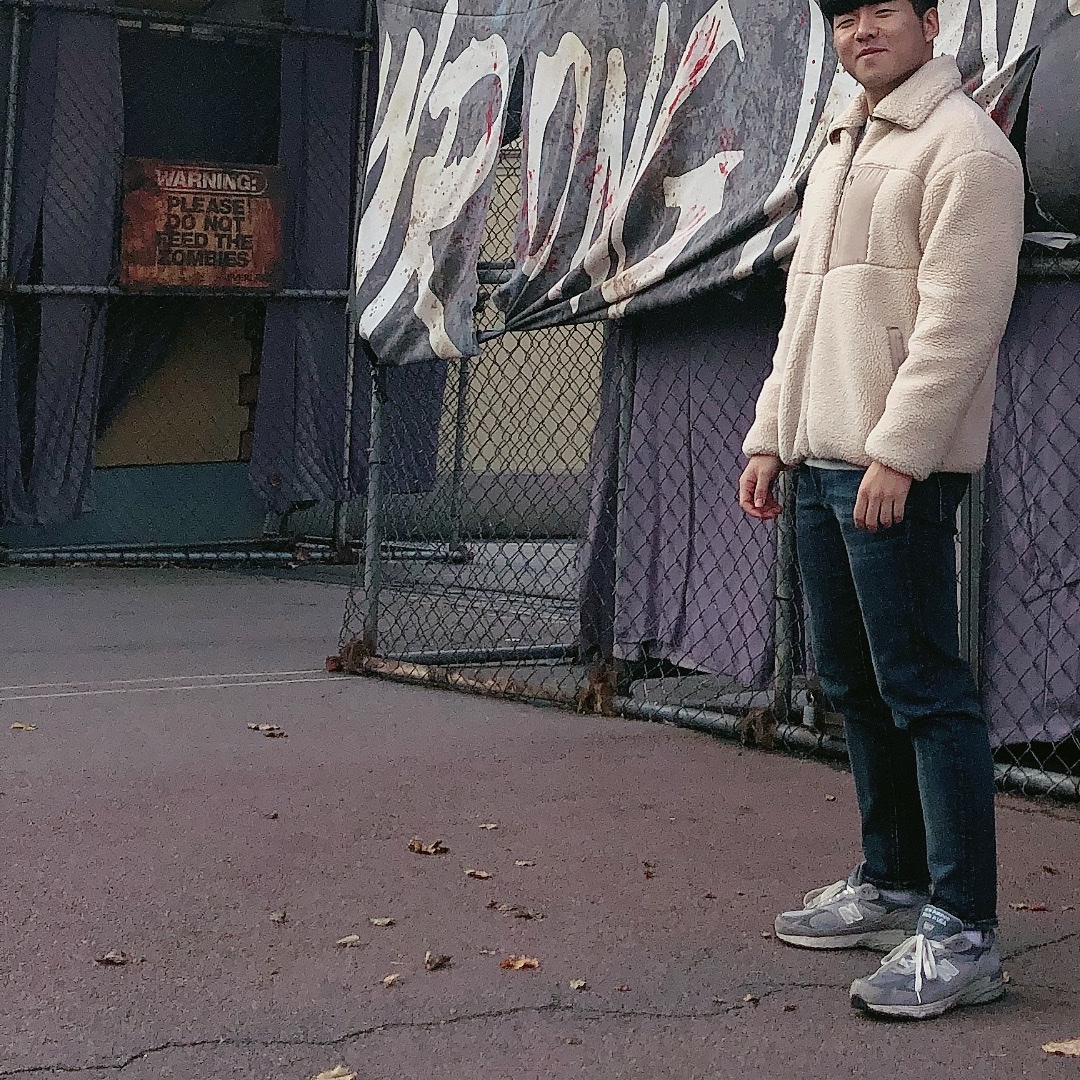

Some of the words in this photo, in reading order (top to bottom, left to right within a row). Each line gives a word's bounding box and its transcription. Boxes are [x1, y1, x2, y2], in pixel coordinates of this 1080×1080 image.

[156, 169, 257, 191] WARNING:
[166, 195, 246, 215] PLEASE
[164, 213, 197, 231] DO
[204, 215, 246, 233] NOT
[156, 230, 209, 249] FEED
[215, 233, 254, 250] THE
[158, 248, 251, 268] ZOMBIES
